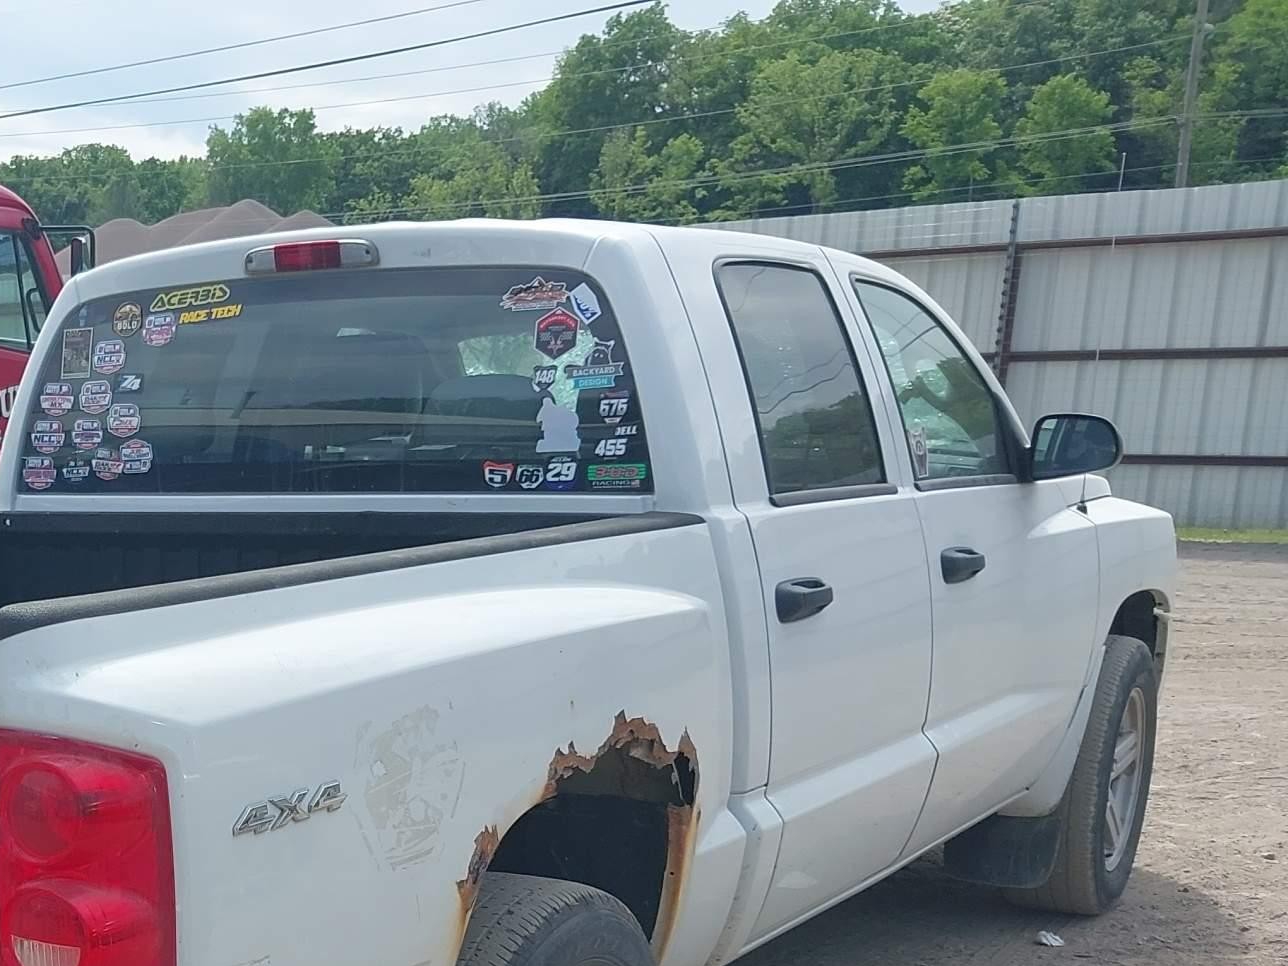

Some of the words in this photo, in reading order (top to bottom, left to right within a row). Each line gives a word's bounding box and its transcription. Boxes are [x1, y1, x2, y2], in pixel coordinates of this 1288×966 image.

[150, 284, 231, 312] ACERBIS
[178, 309, 208, 324] RACE
[211, 304, 244, 320] TECH
[535, 369, 555, 384] 148
[572, 366, 616, 377] BACKYARD
[578, 378, 609, 387] DESIGN
[595, 438, 628, 457] 455
[487, 468, 508, 484] 5
[520, 467, 541, 484] 66
[545, 462, 577, 482] 29
